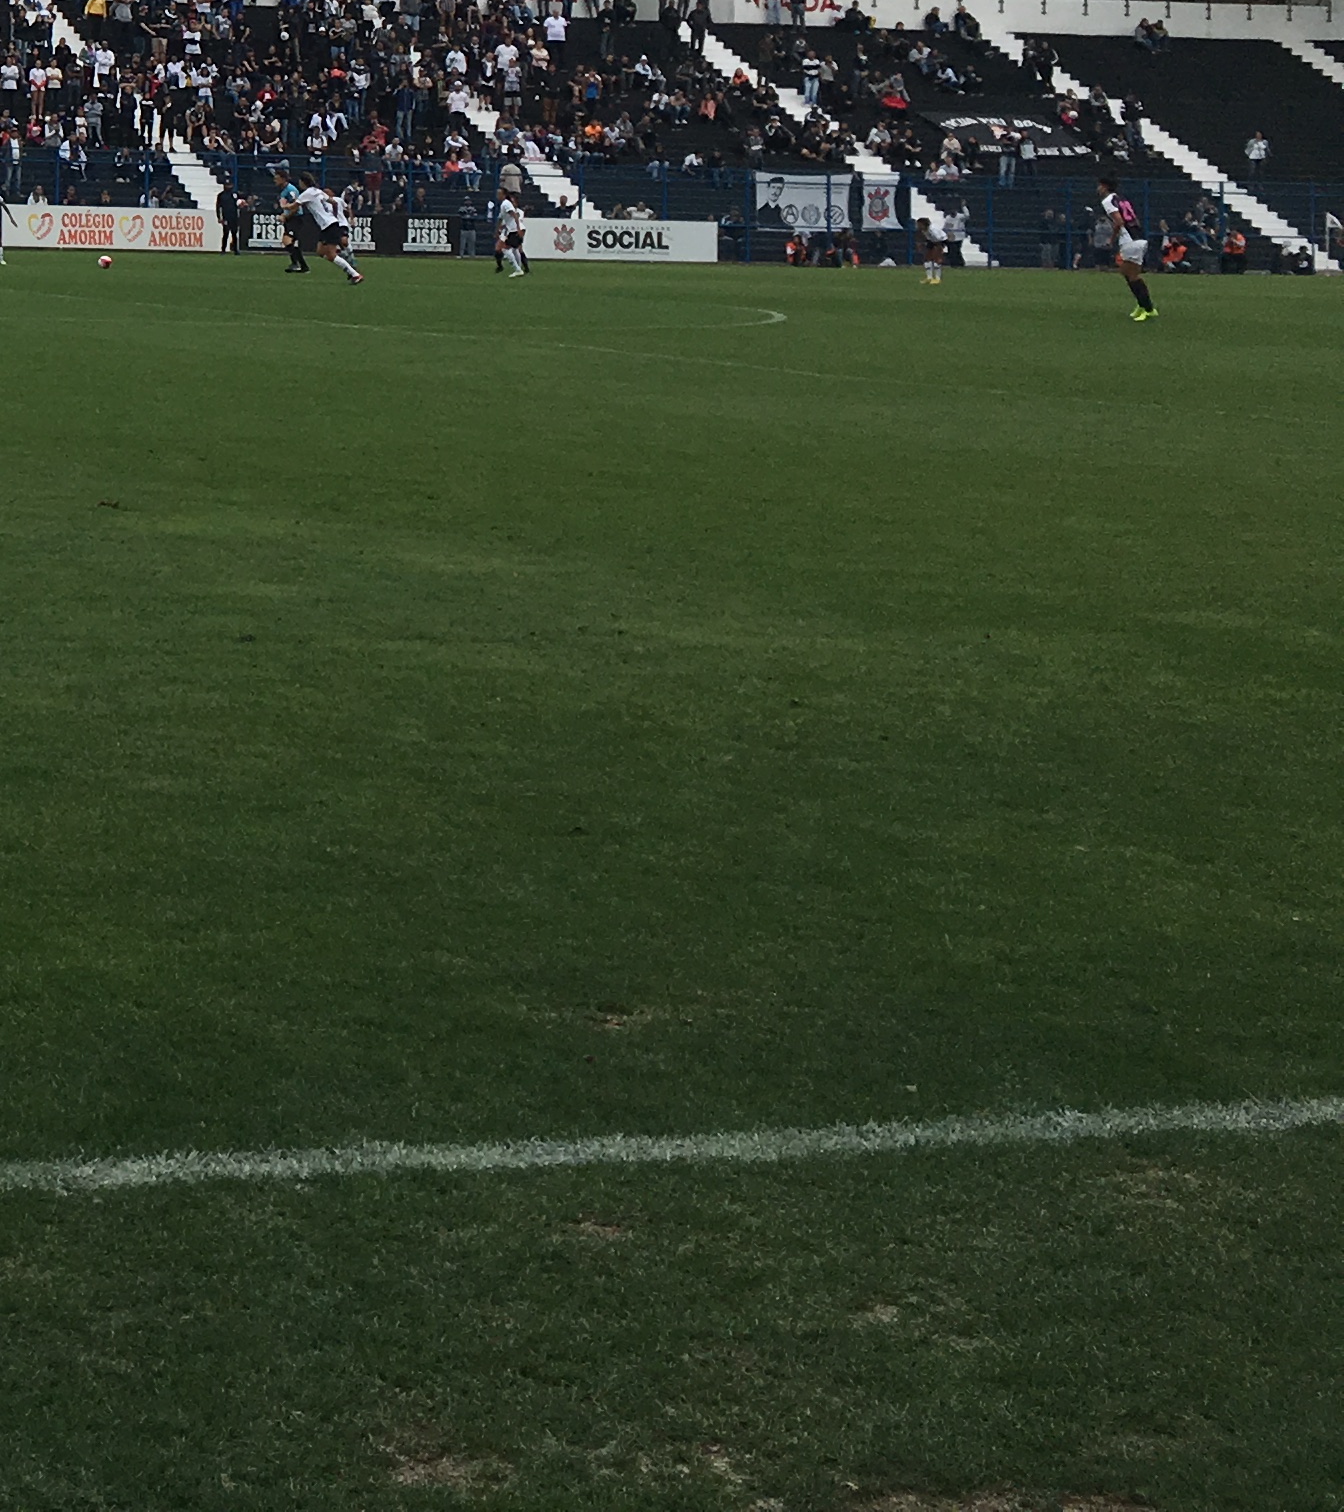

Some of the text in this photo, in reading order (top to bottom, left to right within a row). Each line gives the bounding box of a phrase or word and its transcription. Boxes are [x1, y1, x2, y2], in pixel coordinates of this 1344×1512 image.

[61, 210, 115, 229] COLÉGIO
[151, 212, 204, 230] COLÉGIO
[408, 219, 448, 228] CROSSFIT
[57, 229, 114, 245] AMORIM
[148, 231, 204, 248] AMORIM
[253, 224, 285, 239] PISO
[407, 229, 448, 244] PISOS
[587, 230, 669, 250] SOCIAL
